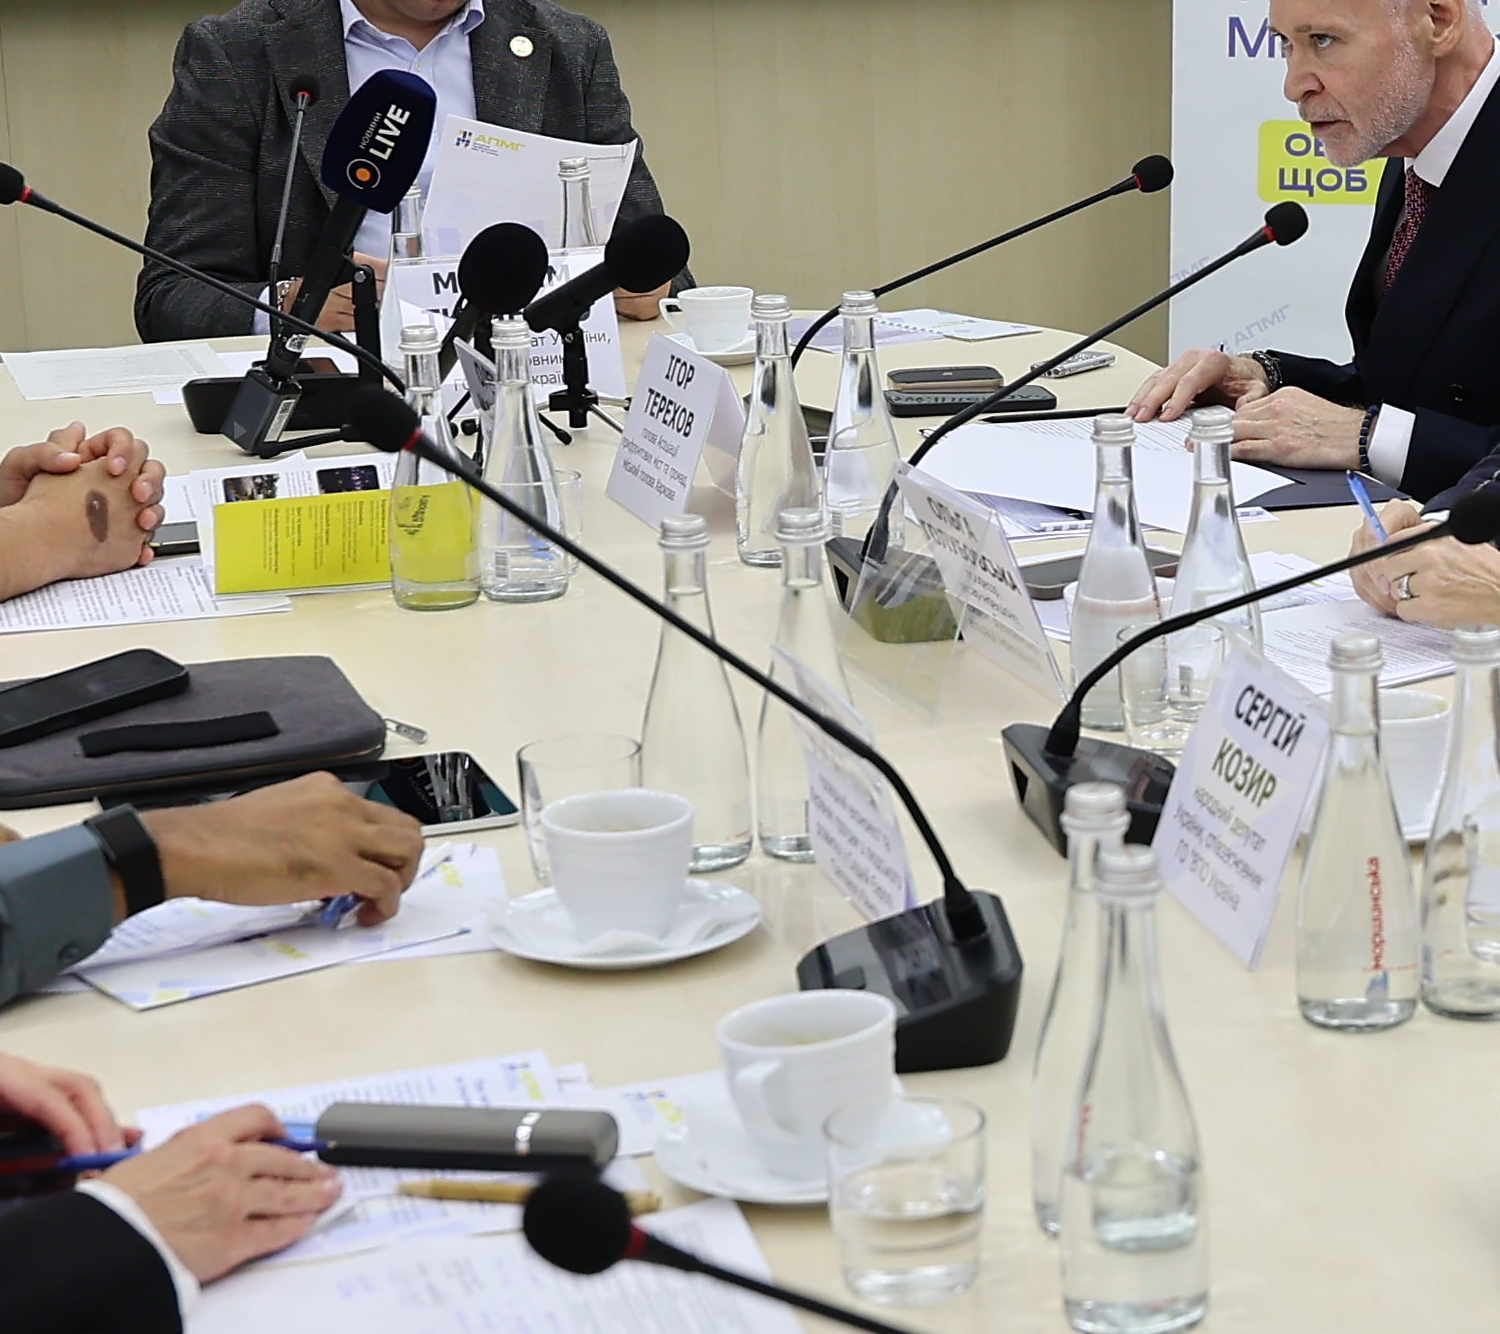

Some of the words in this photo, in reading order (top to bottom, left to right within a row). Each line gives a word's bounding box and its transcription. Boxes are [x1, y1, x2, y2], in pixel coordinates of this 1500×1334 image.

[369, 104, 411, 160] LIVE
[1279, 168, 1367, 197] ЩОБ
[664, 353, 696, 390] ІГОР
[643, 387, 695, 438] ТЕРЕХОВ
[1232, 679, 1306, 757] СЕРГІЙ
[1210, 735, 1277, 808] КОЗИР
